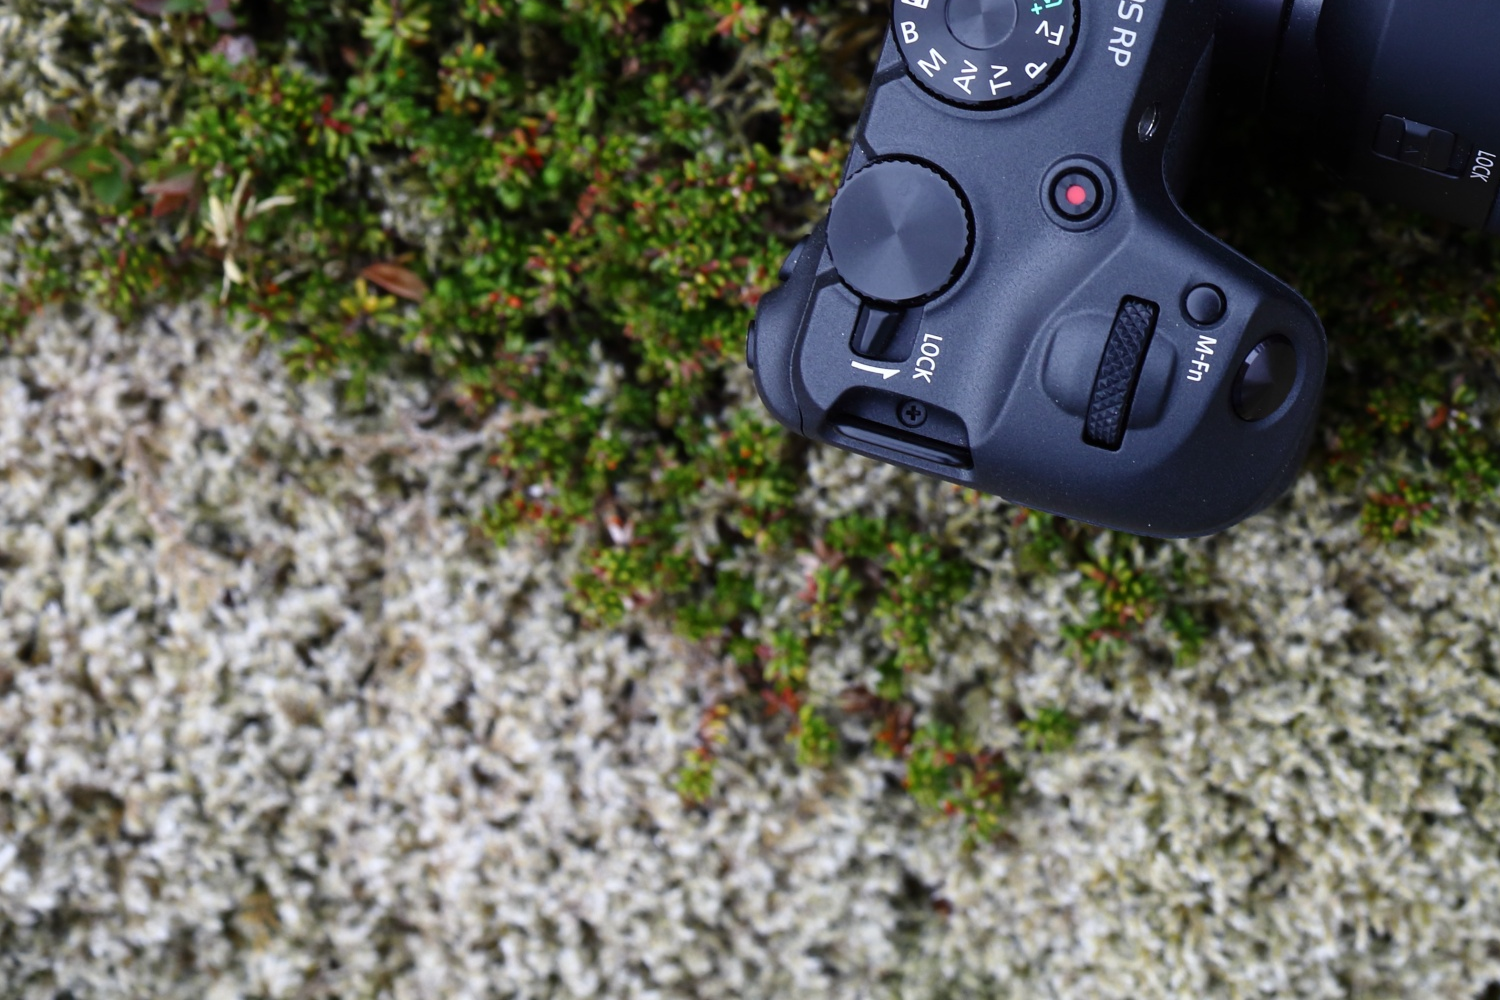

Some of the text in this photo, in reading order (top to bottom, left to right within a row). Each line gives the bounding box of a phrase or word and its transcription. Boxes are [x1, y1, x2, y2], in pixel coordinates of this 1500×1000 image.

[901, 20, 919, 44] B
[1108, 26, 1137, 67] RP
[917, 48, 947, 77] M
[1024, 59, 1048, 79] P
[1470, 149, 1496, 182] LOCK
[912, 333, 943, 384] LOCK
[1186, 335, 1217, 382] M-Fn
